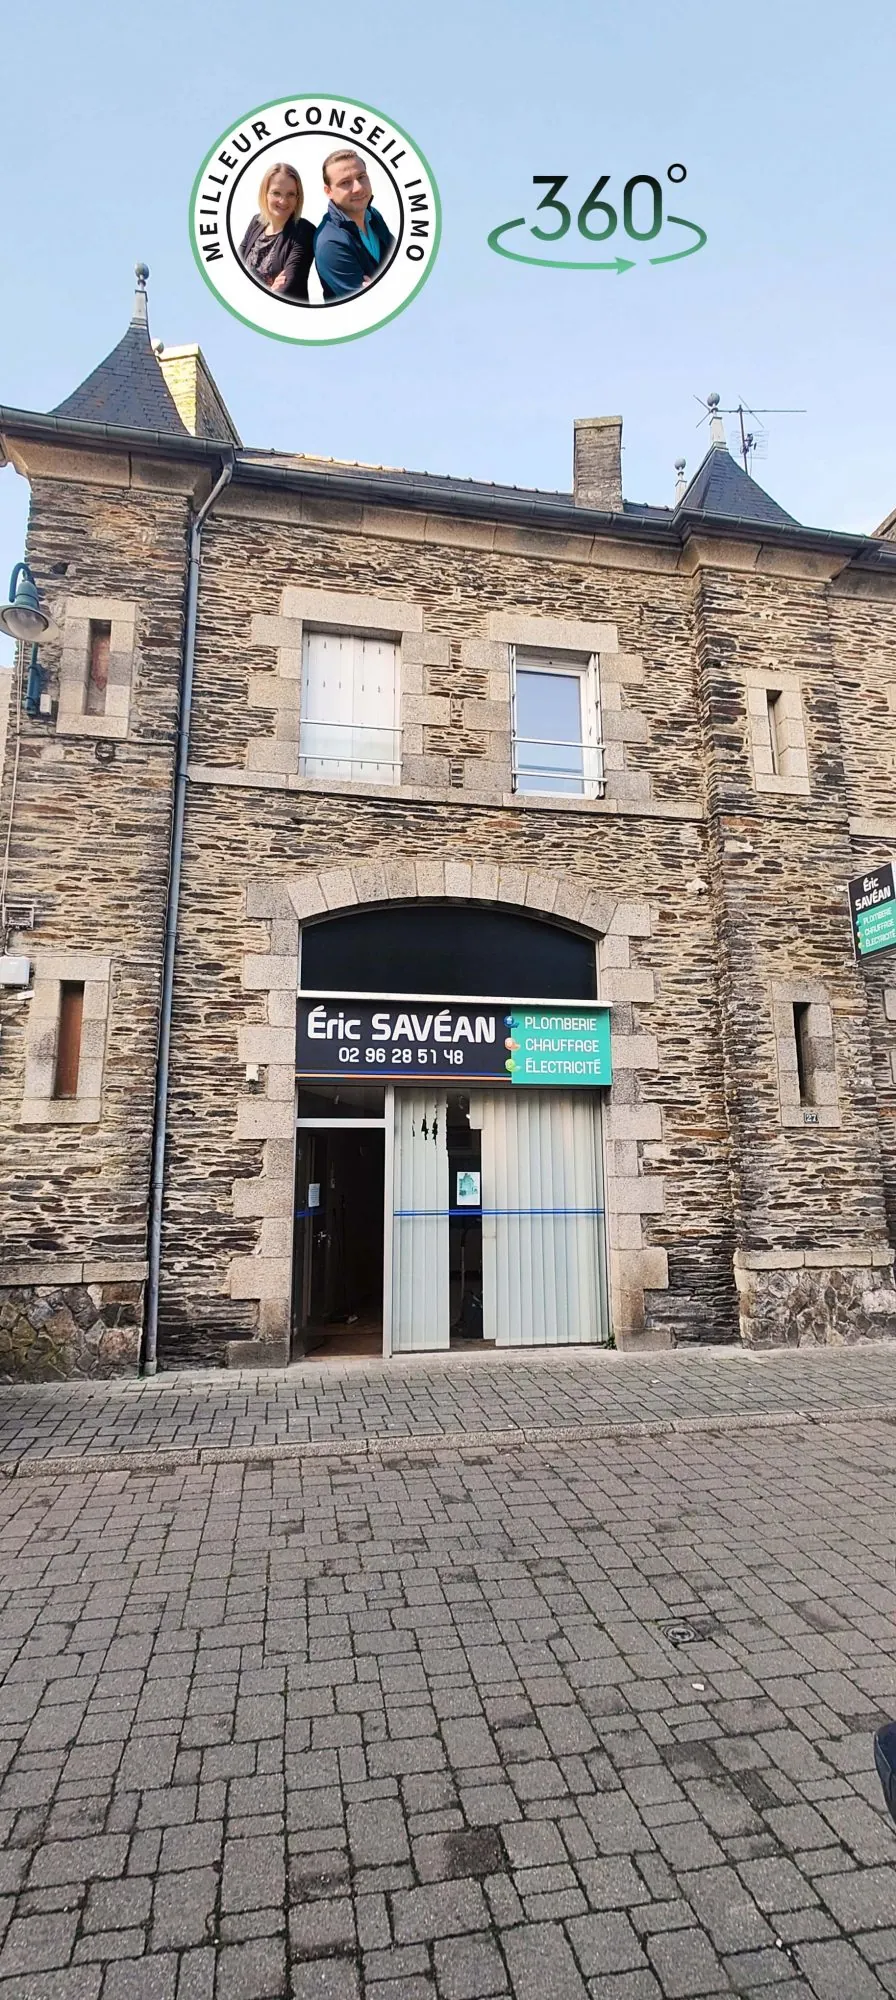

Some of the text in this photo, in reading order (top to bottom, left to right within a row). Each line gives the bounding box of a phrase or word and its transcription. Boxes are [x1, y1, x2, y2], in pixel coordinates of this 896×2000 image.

[863, 877, 879, 893] Éric
[855, 885, 891, 911] SAVÉAN
[307, 1005, 496, 1044] Éric SAVÉAN
[524, 1016, 598, 1032] PLOMBERIE
[525, 1038, 600, 1053] CHAUFFAGE
[338, 1047, 464, 1065] 02 96 28 51 48
[525, 1057, 602, 1075] ÉLECTRICITÉ
[806, 1114, 817, 1122] 27
